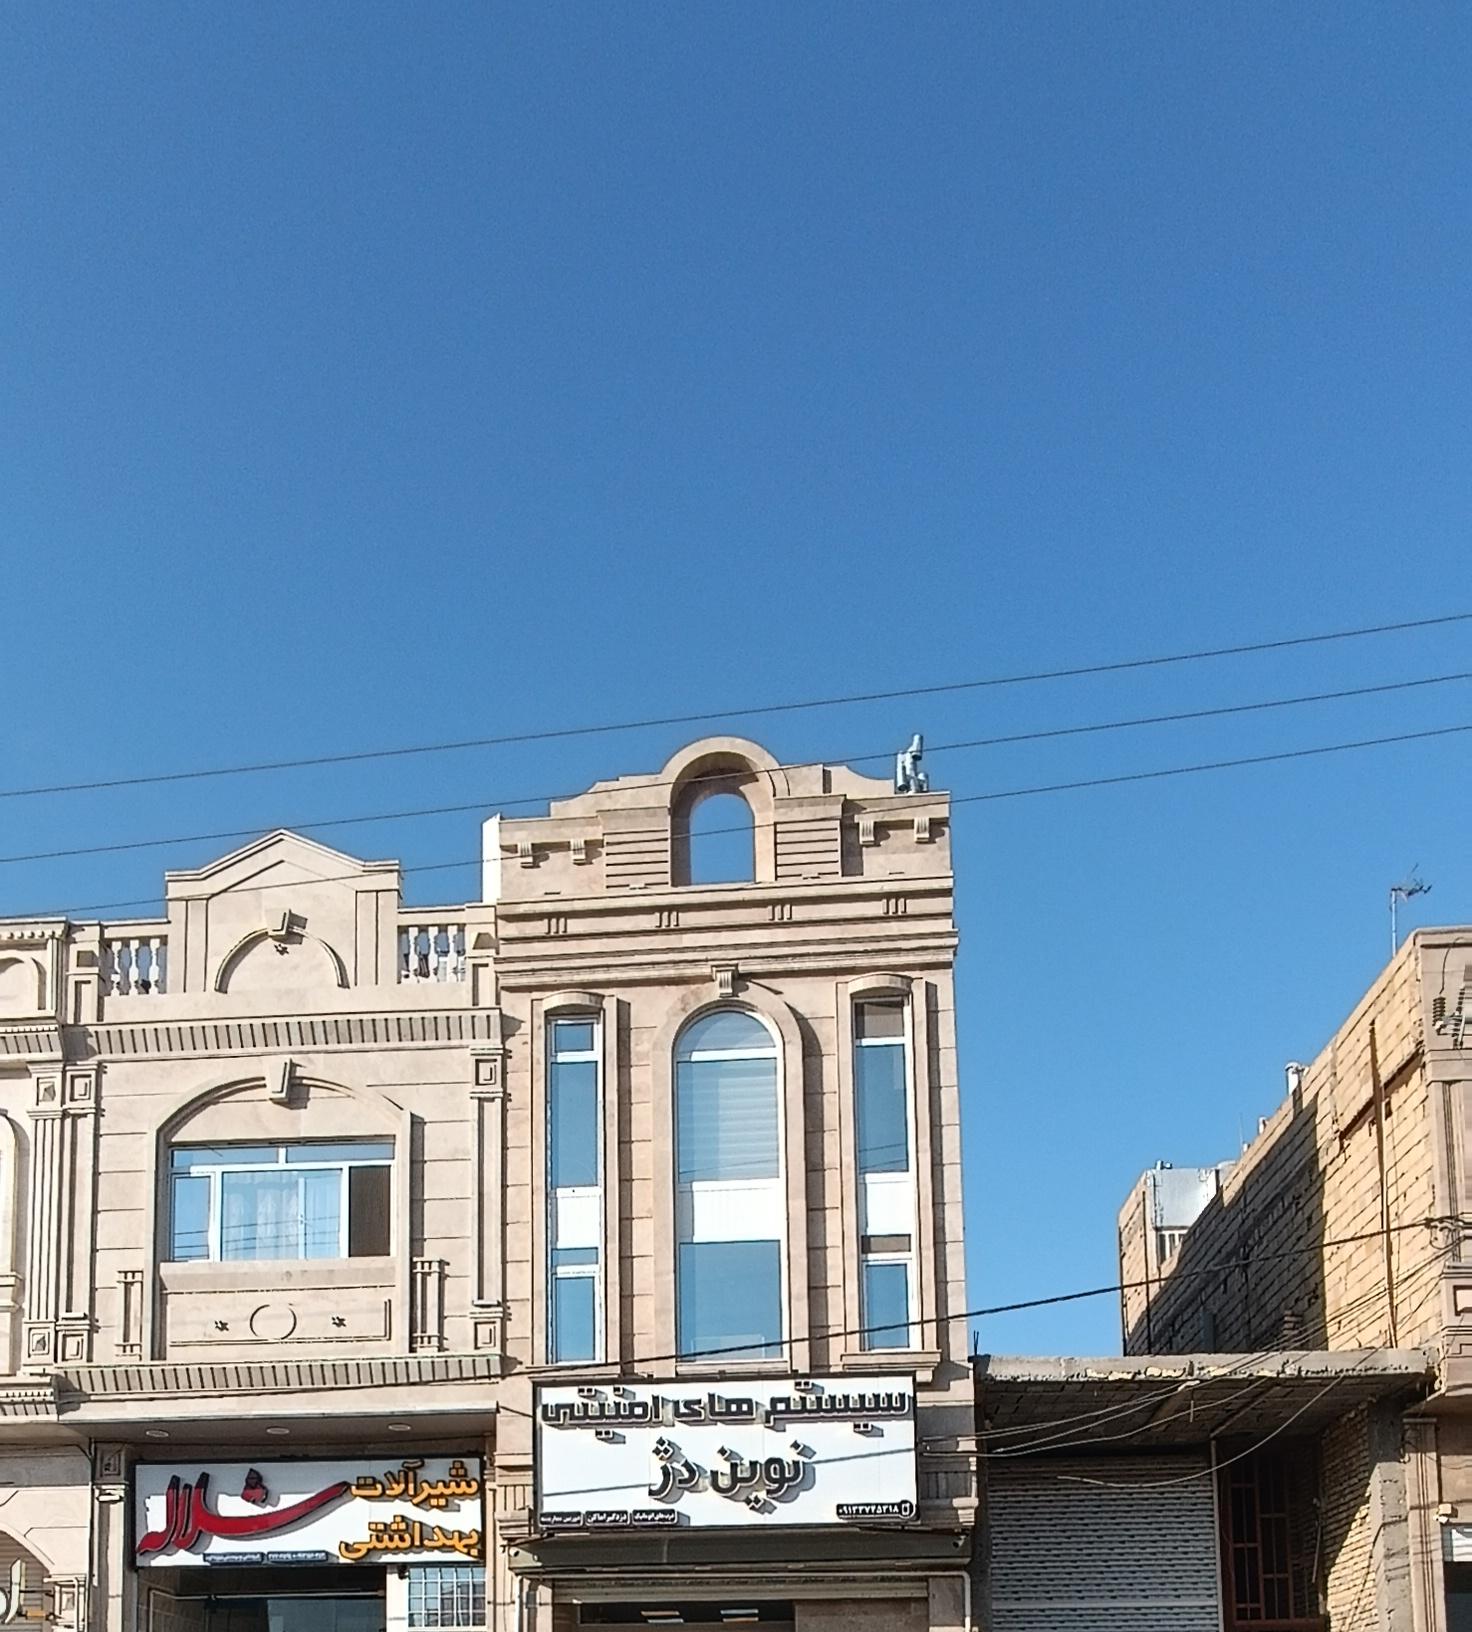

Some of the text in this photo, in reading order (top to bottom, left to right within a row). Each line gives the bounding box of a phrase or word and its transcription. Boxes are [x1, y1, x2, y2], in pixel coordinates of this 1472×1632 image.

[542, 1379, 910, 1440] سیستم های امنیتی
[351, 1458, 480, 1506] شیرآلات
[648, 1436, 808, 1510] نوین دژ
[338, 1514, 482, 1562] بهداشتی
